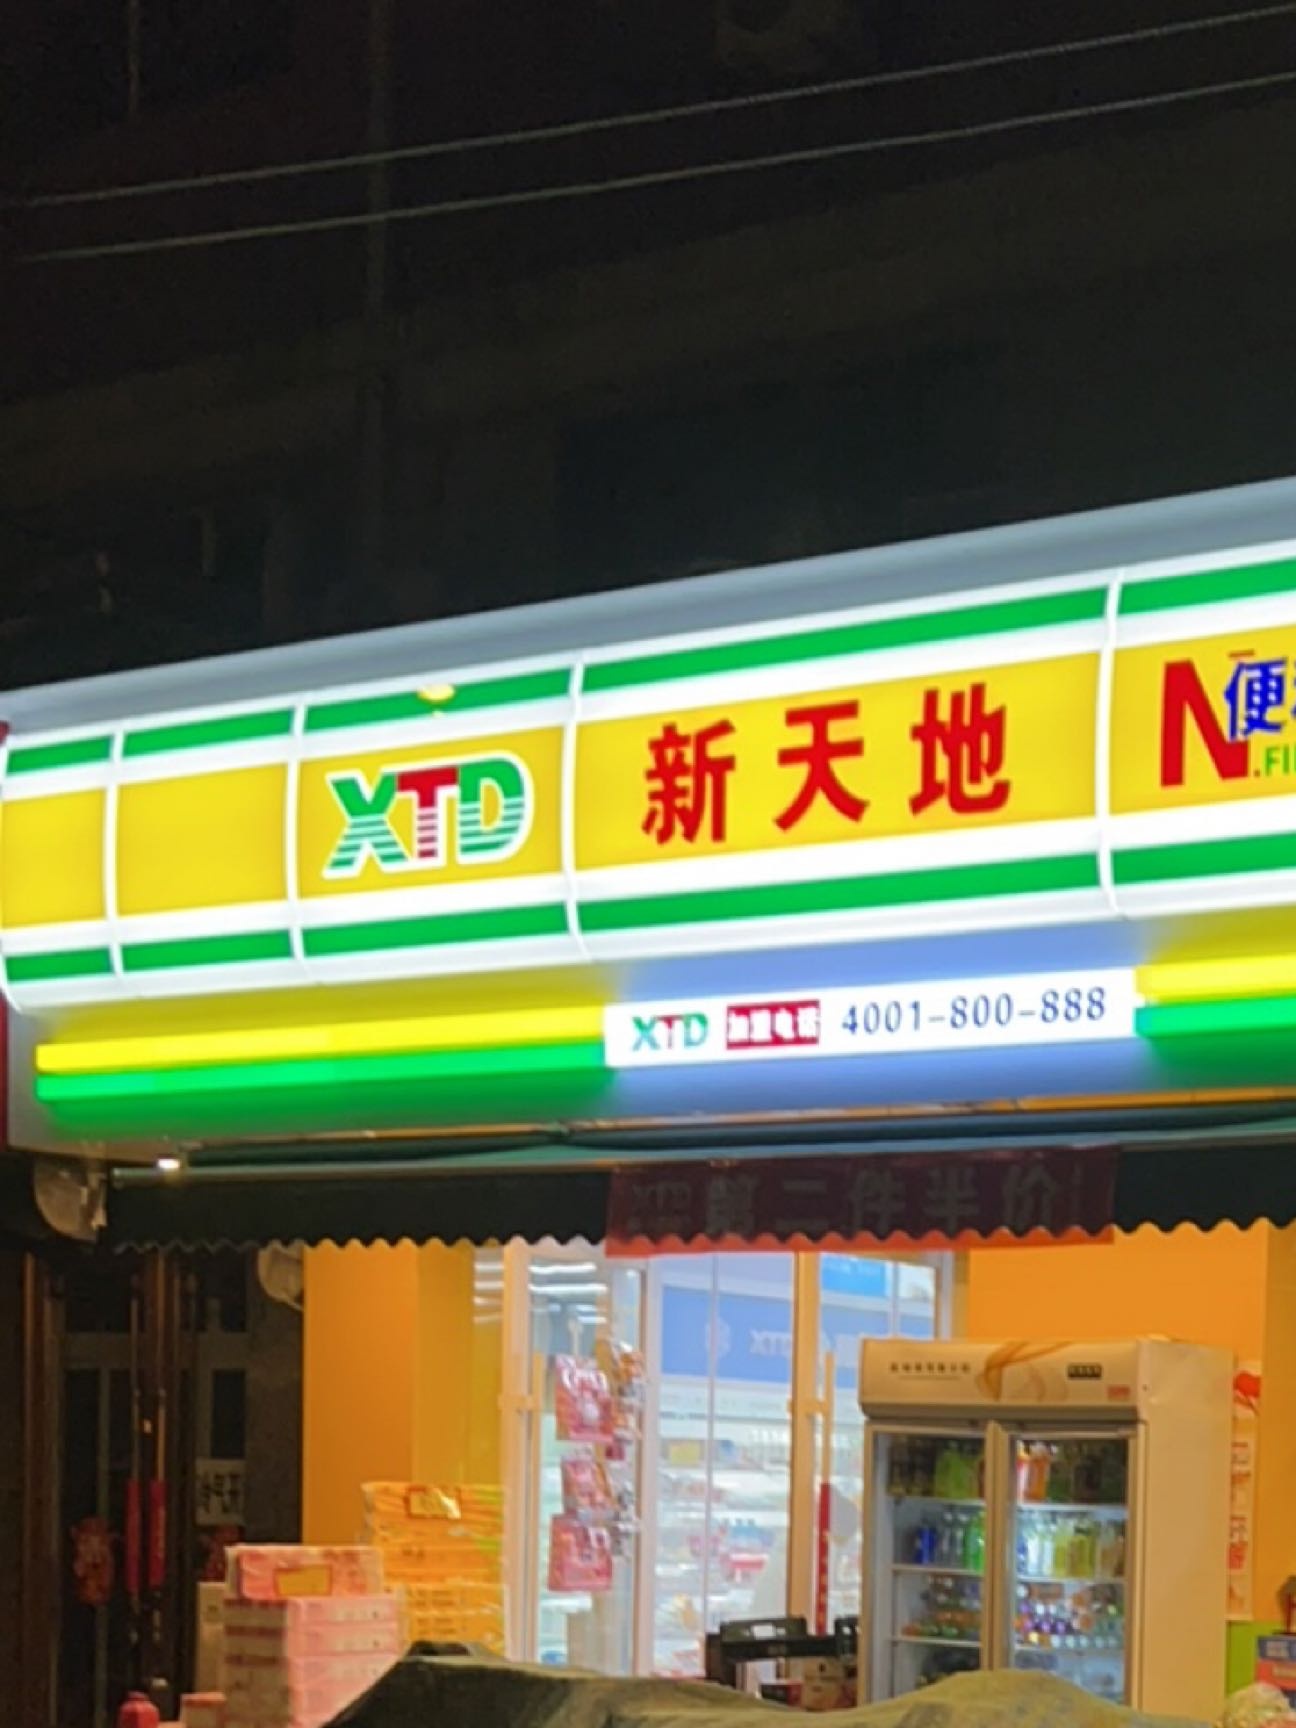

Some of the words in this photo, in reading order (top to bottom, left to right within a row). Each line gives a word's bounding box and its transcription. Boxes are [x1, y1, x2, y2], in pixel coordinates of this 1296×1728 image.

[324, 754, 530, 876] XTD
[641, 682, 1012, 845] 新天地
[631, 1012, 709, 1051] XTD
[841, 987, 1107, 1035] 4001-800-888
